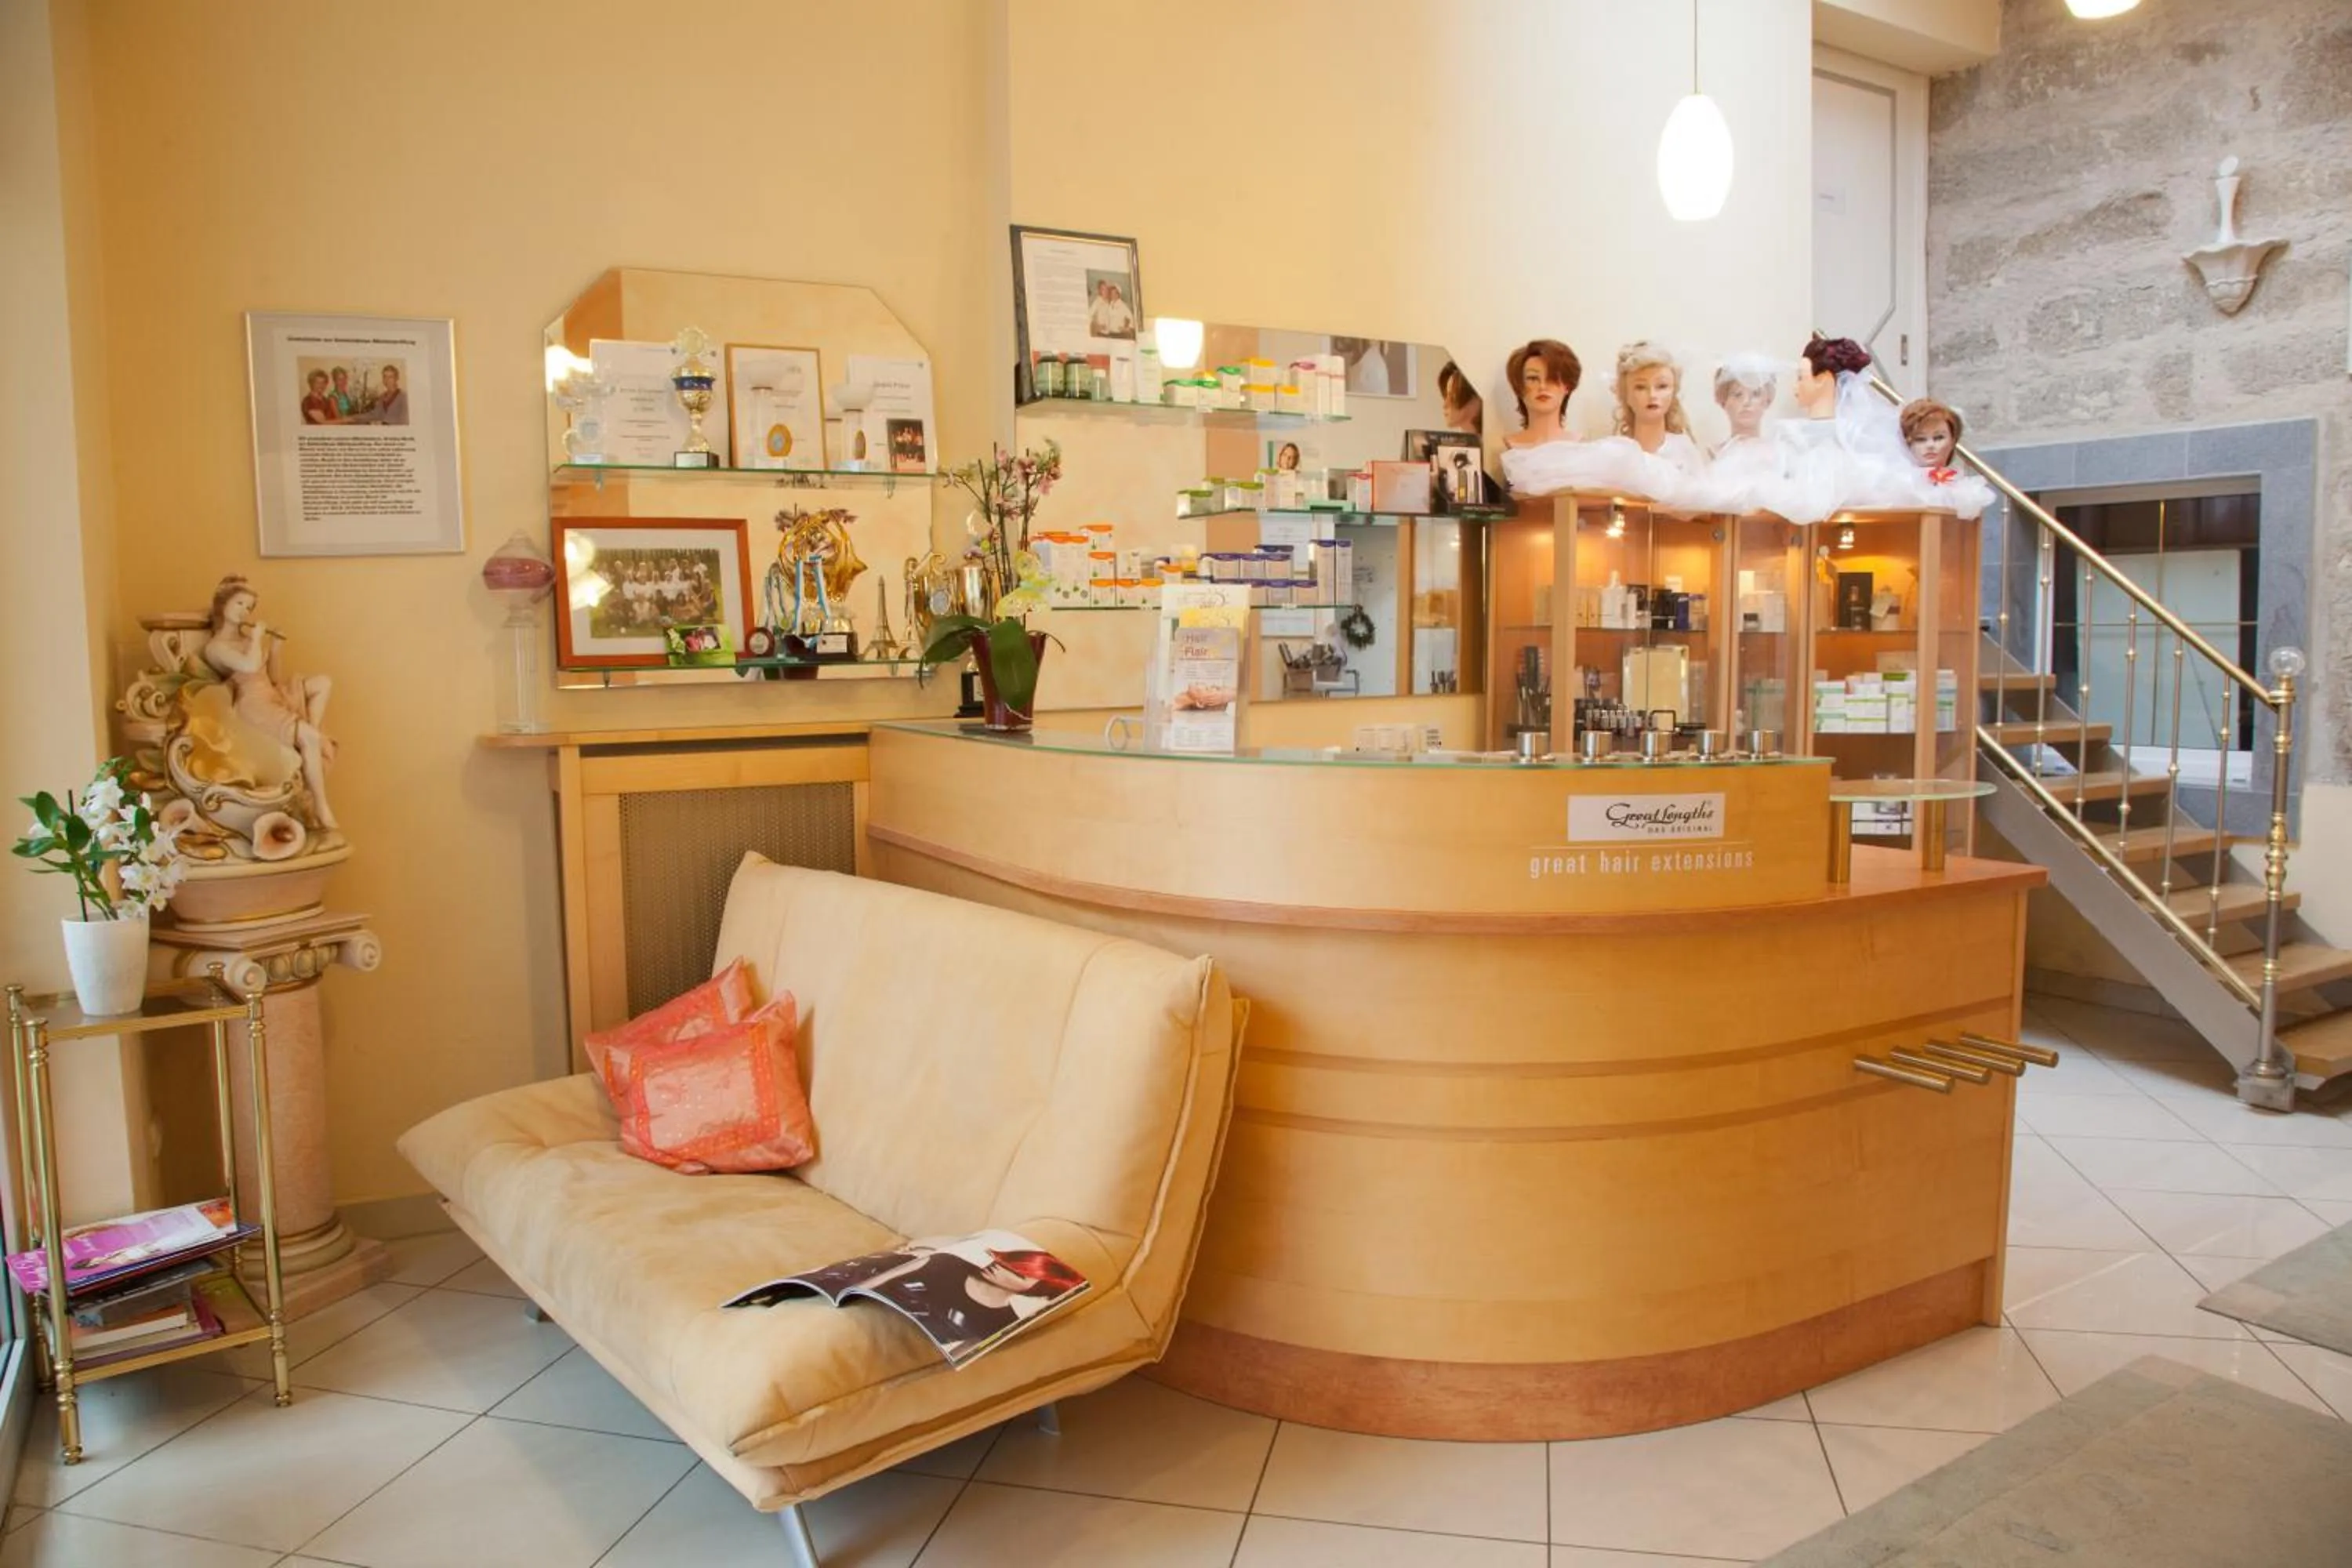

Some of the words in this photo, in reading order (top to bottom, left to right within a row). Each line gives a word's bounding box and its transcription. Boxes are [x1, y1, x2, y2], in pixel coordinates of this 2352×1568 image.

[1185, 646, 1208, 657] Flair
[1606, 803, 1660, 829] Great
[1530, 853, 1587, 879] great
[1600, 850, 1640, 873] hair
[1651, 846, 1754, 872] extensions
